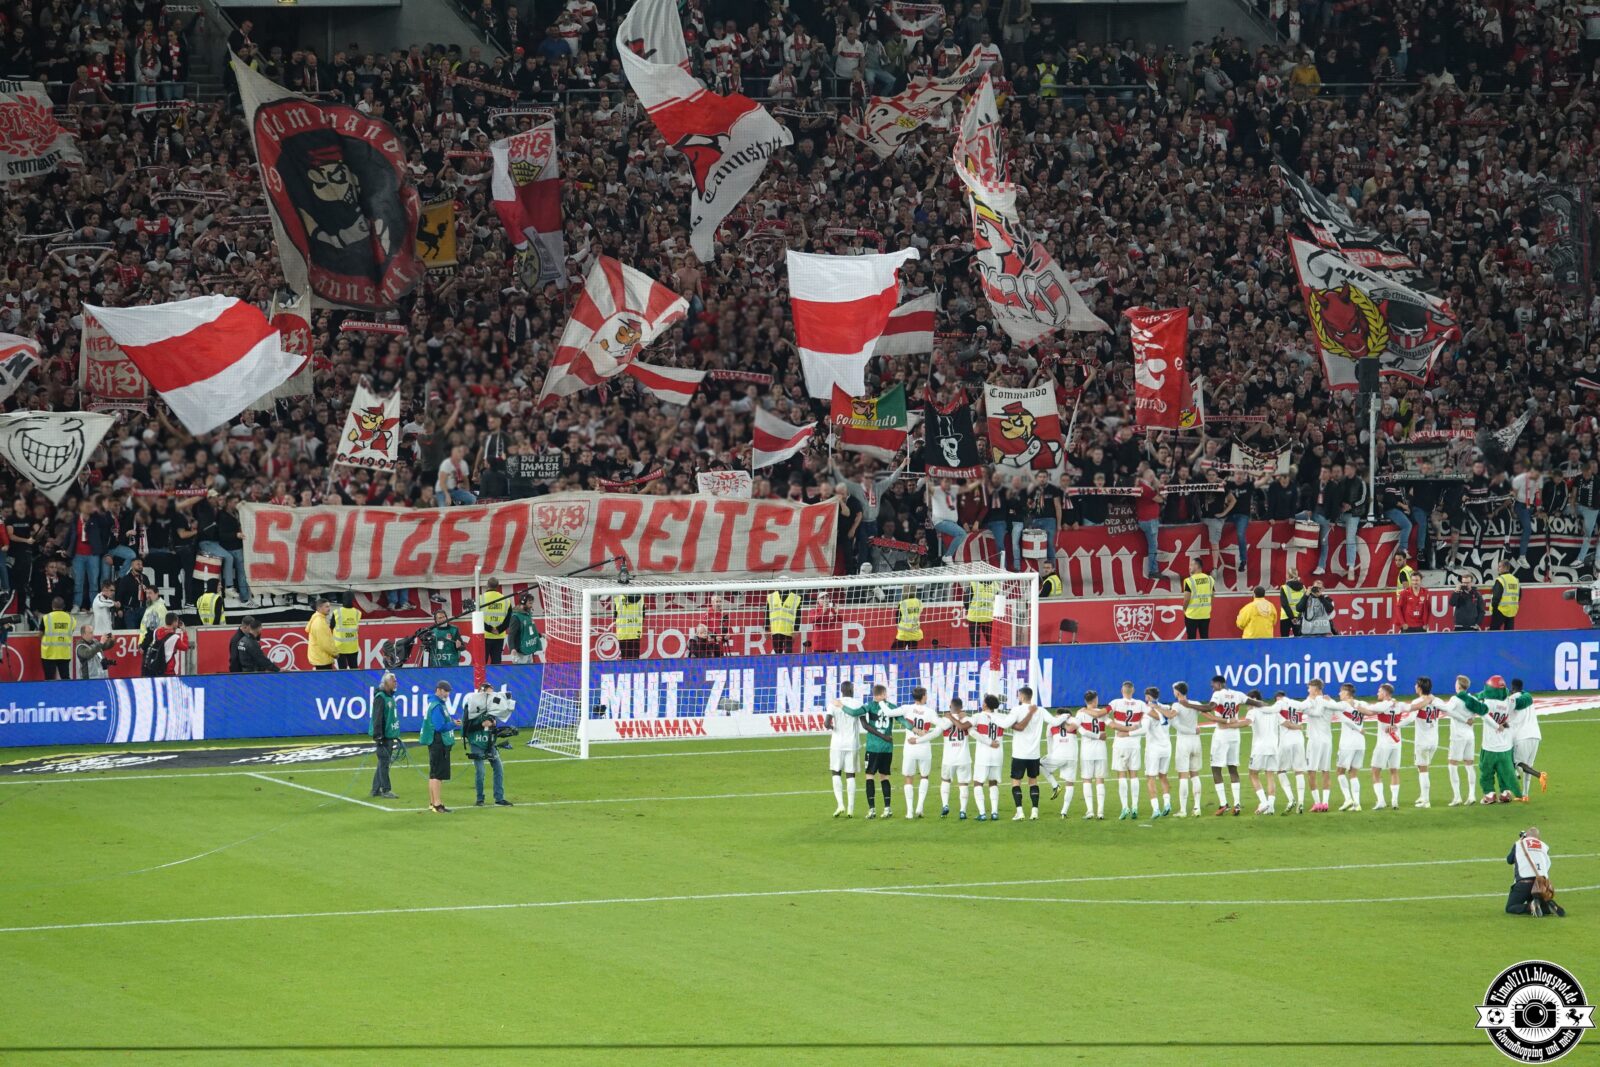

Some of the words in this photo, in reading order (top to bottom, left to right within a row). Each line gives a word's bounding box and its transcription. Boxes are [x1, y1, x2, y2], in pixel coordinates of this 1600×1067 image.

[0, 81, 23, 93] 0711
[7, 149, 63, 175] STUTTGART
[704, 136, 783, 204] Cannstatt
[990, 387, 1047, 400] Commando
[836, 413, 897, 429] Commando
[521, 455, 534, 463] DU
[539, 455, 560, 463] BIST
[521, 463, 560, 471] IMMER
[928, 465, 977, 478] Cannstatt
[1166, 484, 1219, 493] COMMANDO
[251, 503, 530, 583] SPITZEN
[589, 498, 837, 573] REITER
[1330, 530, 1402, 590] 97
[1117, 606, 1153, 627] VfB
[116, 637, 138, 658] 34
[1215, 652, 1398, 687] wohninvest
[1554, 641, 1600, 690] GE
[600, 670, 684, 719] MUT
[705, 668, 755, 717] ZU
[776, 662, 898, 714] NEUEN
[874, 709, 888, 729] 33
[1125, 709, 1134, 727] 2
[1223, 702, 1236, 720] 23
[1426, 706, 1438, 724] 21
[614, 718, 708, 739] WINAMAX
